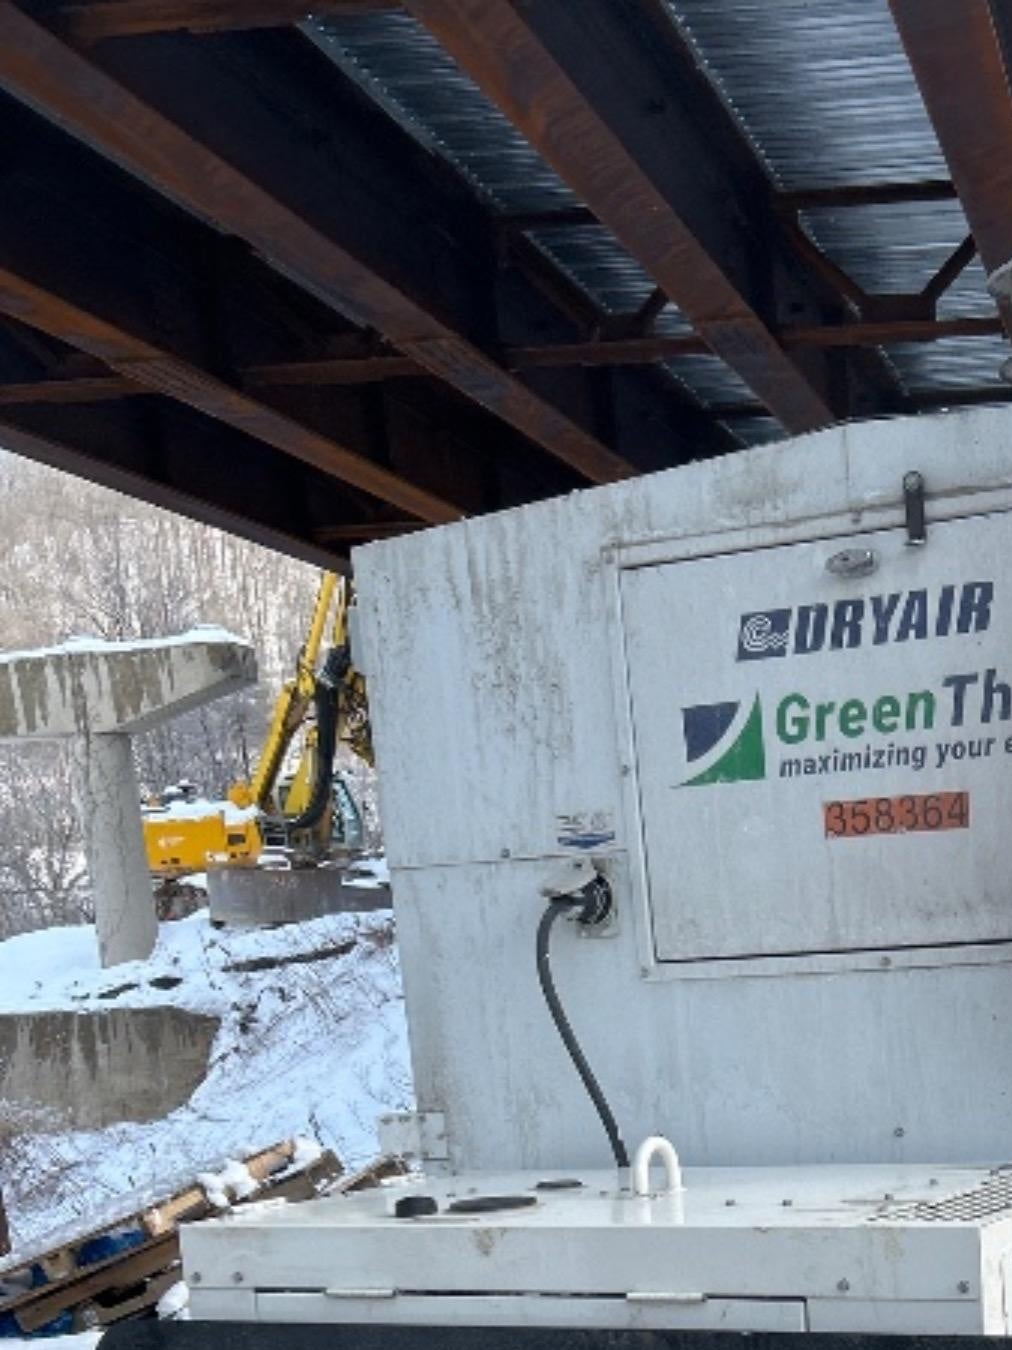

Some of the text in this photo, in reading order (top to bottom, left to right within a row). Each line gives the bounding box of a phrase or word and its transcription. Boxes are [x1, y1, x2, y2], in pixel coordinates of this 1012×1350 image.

[794, 582, 993, 654] DRYAIR
[780, 743, 926, 777] maximizing
[935, 737, 995, 768] your
[826, 792, 966, 837] 358364
